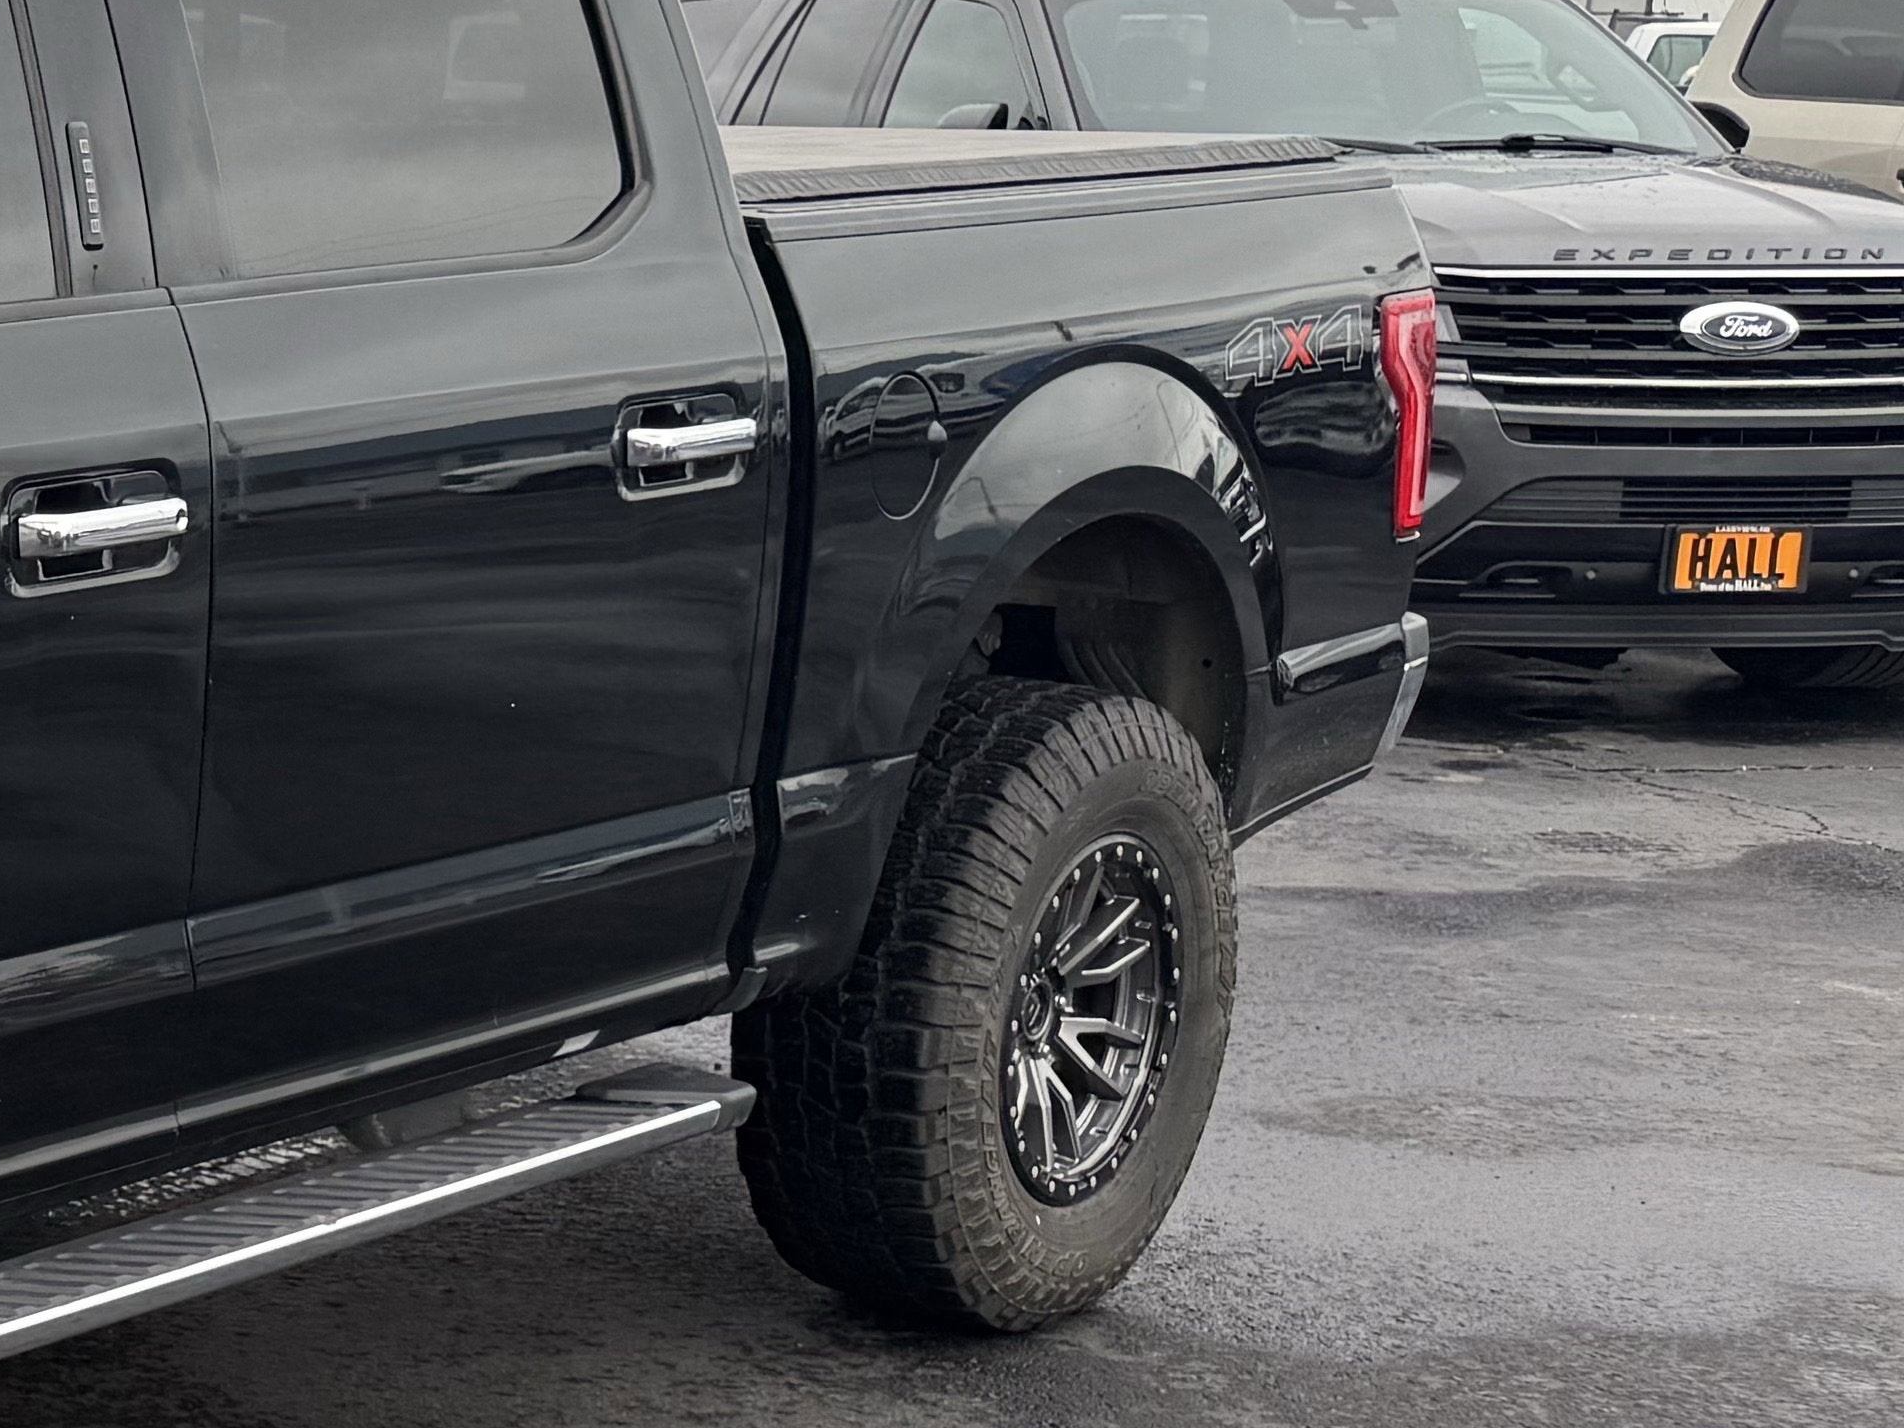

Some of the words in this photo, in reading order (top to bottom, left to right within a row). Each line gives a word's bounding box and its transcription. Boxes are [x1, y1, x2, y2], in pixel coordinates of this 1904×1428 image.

[1553, 247, 1886, 262] EXPEDITION
[1719, 315, 1772, 338] Ford
[1688, 537, 1784, 580] HALL
